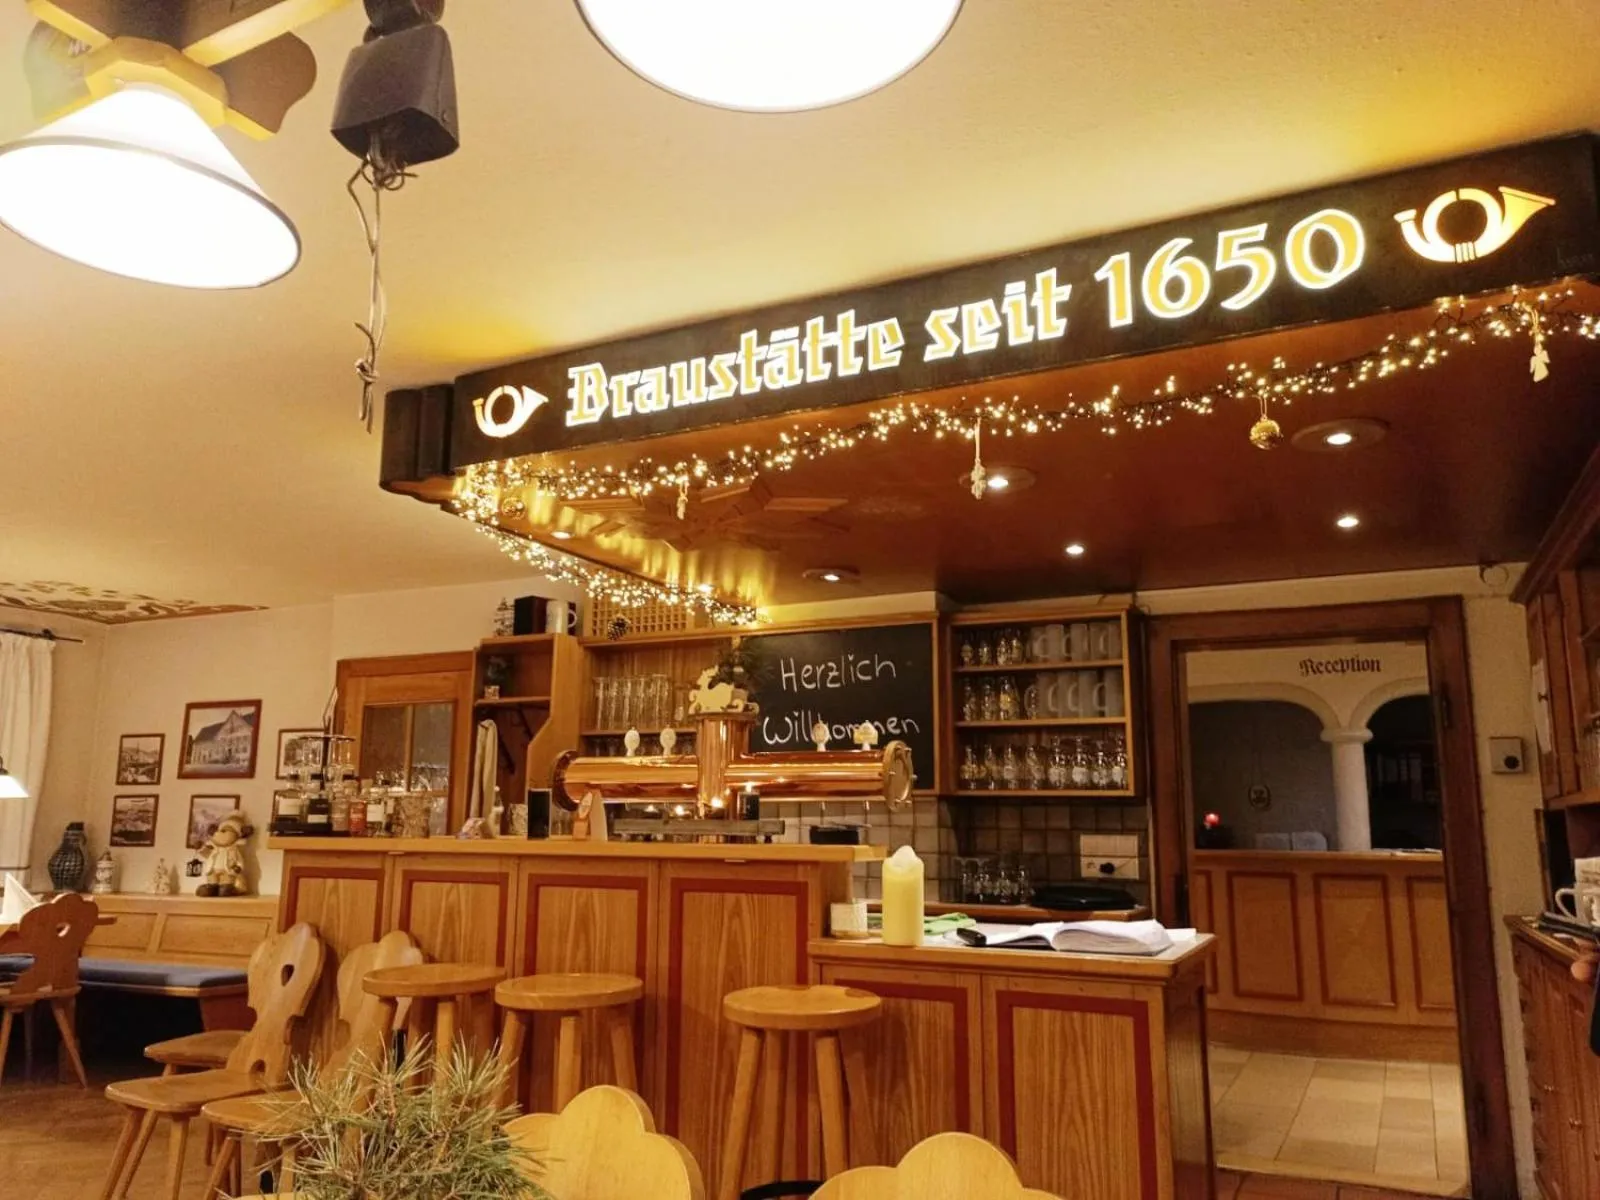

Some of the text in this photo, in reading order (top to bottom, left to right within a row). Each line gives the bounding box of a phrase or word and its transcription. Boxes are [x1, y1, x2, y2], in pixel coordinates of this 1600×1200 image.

[565, 208, 1366, 427] Braustätte seit 1650
[780, 653, 897, 692] Herzlich
[1299, 654, 1382, 677] Reception
